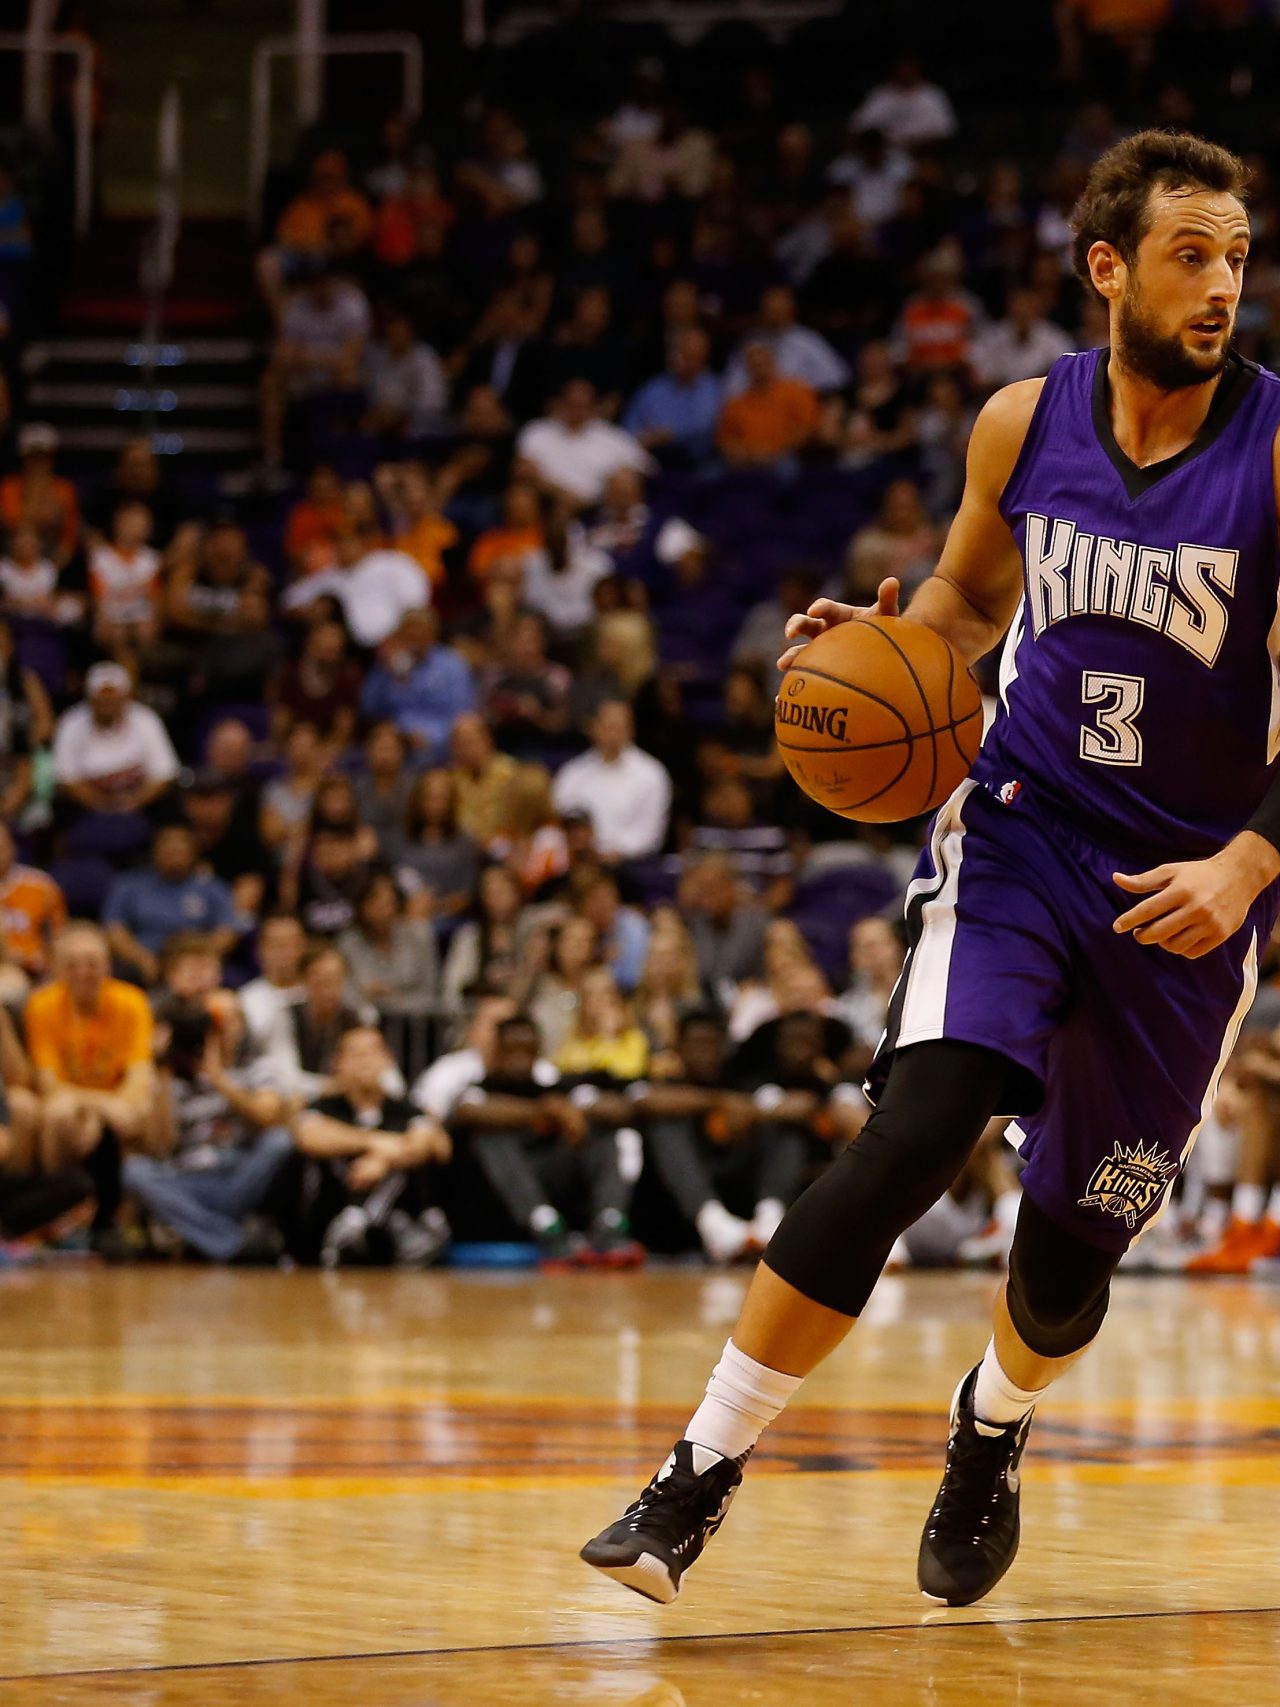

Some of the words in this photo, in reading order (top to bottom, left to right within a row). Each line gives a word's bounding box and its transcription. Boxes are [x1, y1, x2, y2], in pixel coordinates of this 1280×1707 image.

[1026, 512, 1240, 670] KINGS
[777, 699, 847, 741] ALDING
[1079, 670, 1145, 767] 3
[1093, 1164, 1161, 1211] KINGS
